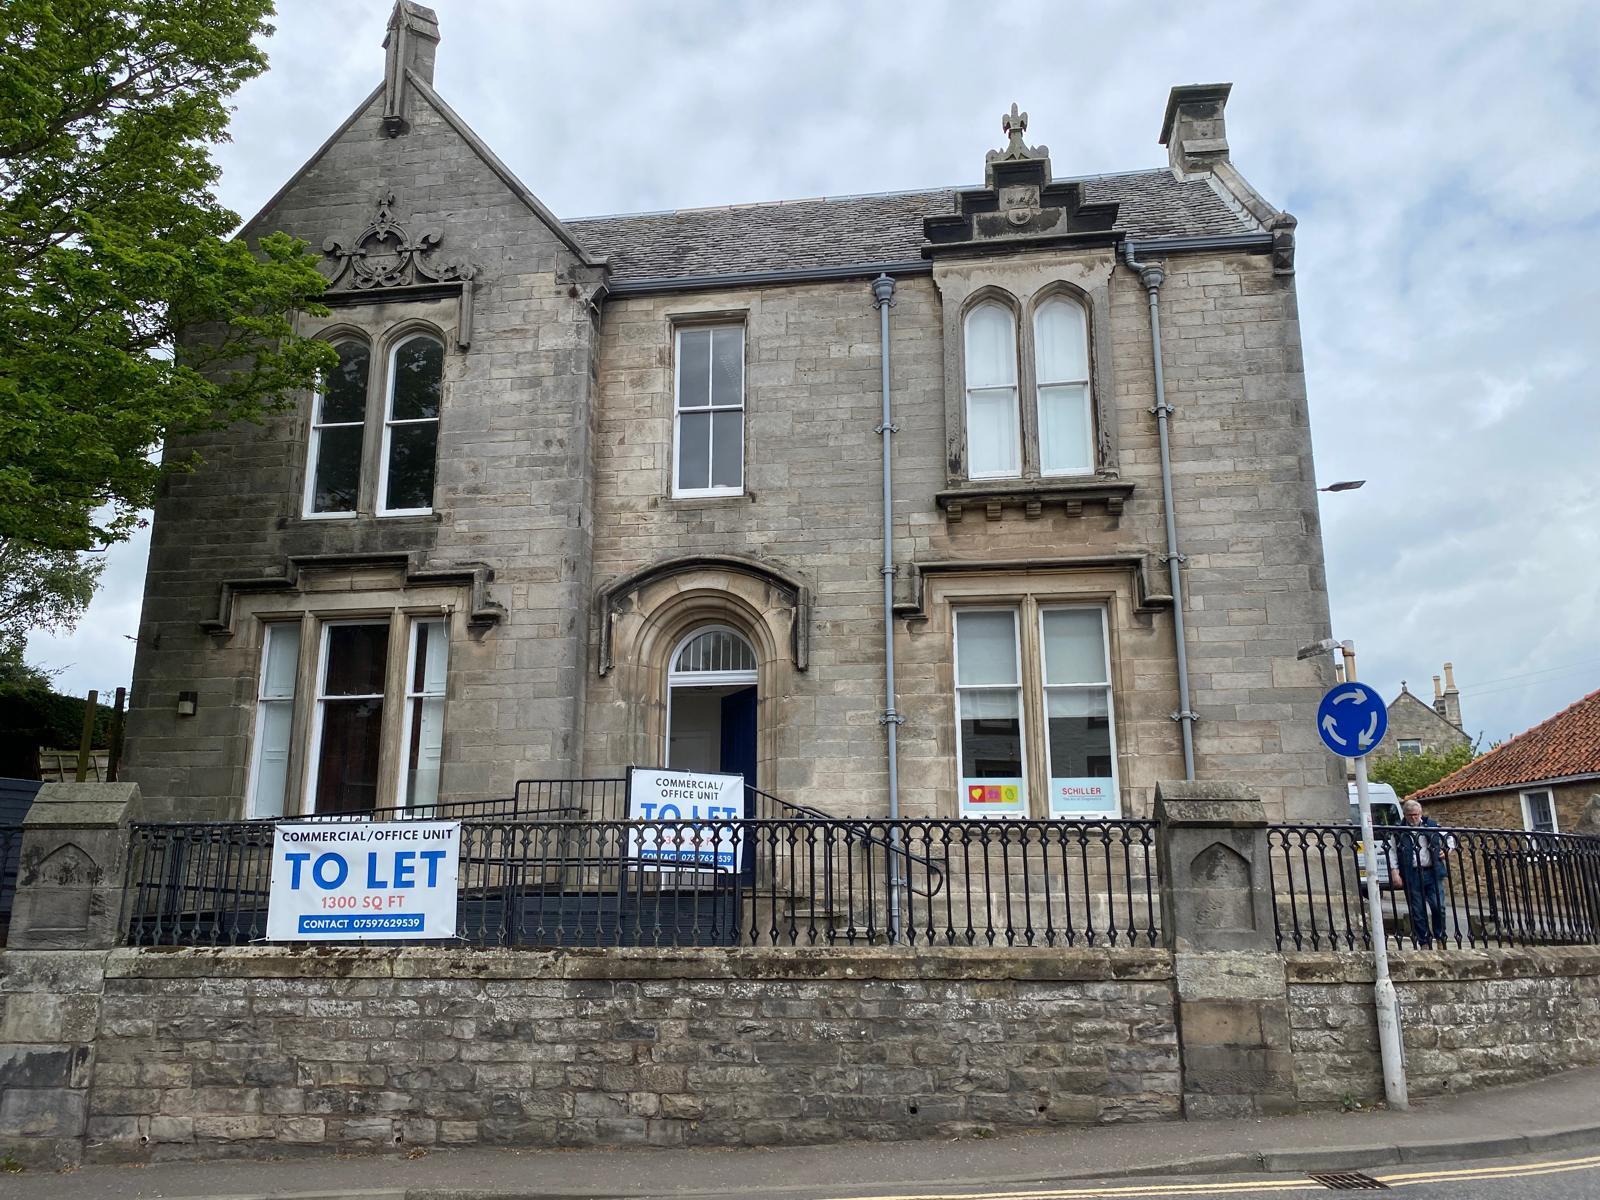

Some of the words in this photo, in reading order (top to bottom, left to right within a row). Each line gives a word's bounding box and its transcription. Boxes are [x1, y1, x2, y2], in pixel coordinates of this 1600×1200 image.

[655, 778, 723, 790] COMMERCIAL/
[661, 789, 694, 799] OFFICE
[697, 791, 719, 801] UNIT
[282, 830, 418, 842] COMMERCIAL/OFFICE
[423, 829, 453, 840] UNIT
[681, 853, 732, 863] 075762539
[285, 852, 349, 890] TO
[366, 851, 446, 888] LET
[321, 896, 357, 909] 1300
[362, 895, 383, 910] SQ
[388, 895, 405, 908] FT
[303, 919, 350, 929] CONTACT
[353, 918, 420, 928] 07597629539
